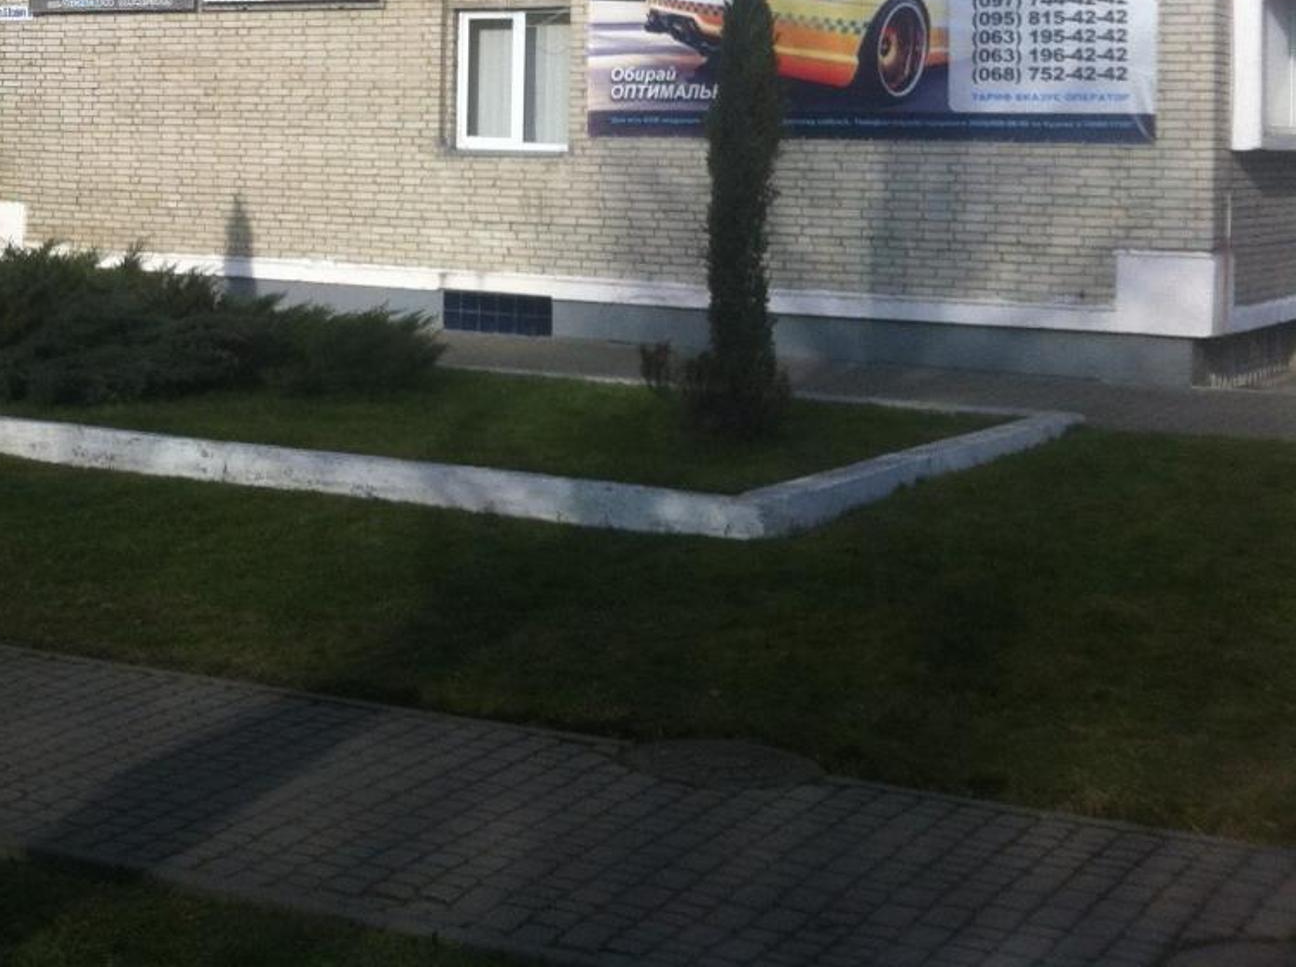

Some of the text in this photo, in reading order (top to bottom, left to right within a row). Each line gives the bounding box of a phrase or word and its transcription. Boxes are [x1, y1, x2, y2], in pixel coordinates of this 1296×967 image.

[972, 9, 1129, 28] (095) 815-42-42
[972, 28, 1129, 47] (063) 195-42-42
[972, 48, 1129, 65] (063) 196-42-42
[611, 66, 677, 84] Обирай
[972, 66, 1129, 83] (068) 752-42-42
